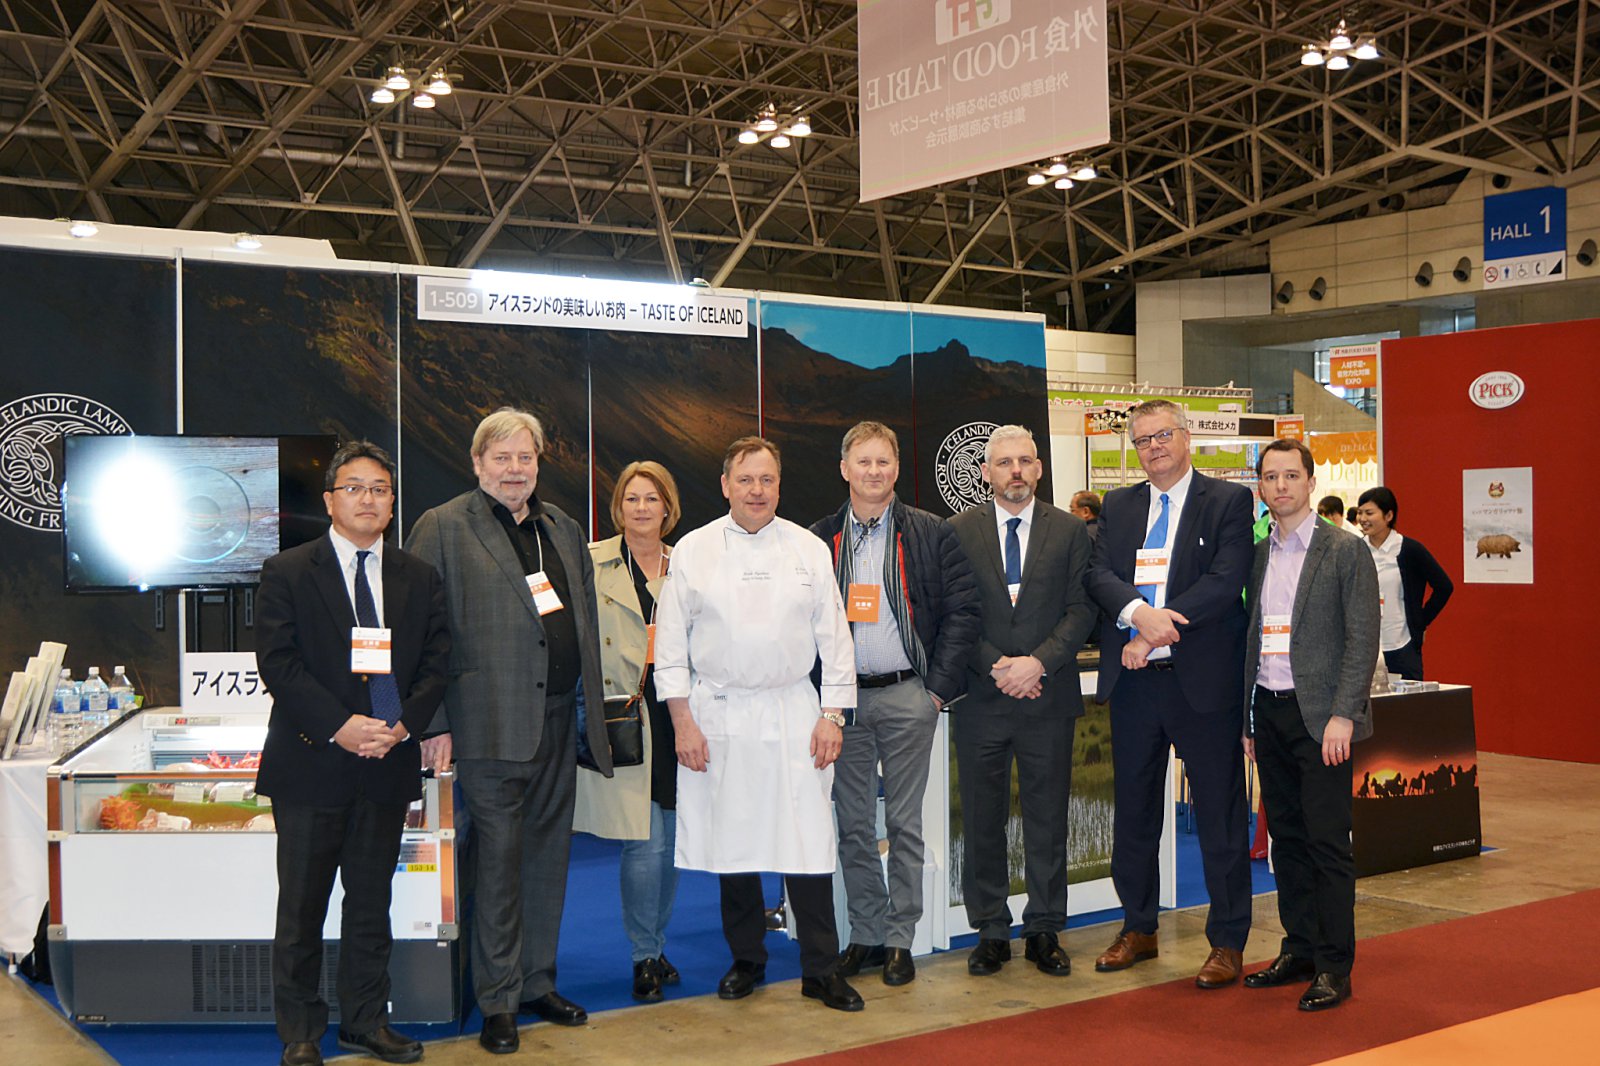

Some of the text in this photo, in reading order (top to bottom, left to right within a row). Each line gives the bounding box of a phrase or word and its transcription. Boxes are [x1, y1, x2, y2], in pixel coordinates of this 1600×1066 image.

[1490, 204, 1551, 242] HALL 1
[429, 290, 478, 310] 1-509
[488, 292, 627, 321] アイスランドの美味しいお肉
[640, 302, 676, 321] TASTE
[678, 305, 694, 322] OF
[697, 306, 744, 325] ICELAND
[1345, 377, 1362, 386] EXPO
[1479, 382, 1513, 399] PICK
[0, 397, 80, 429] ELANDIC
[943, 424, 995, 453] ICELANDIC
[39, 512, 61, 528] FR
